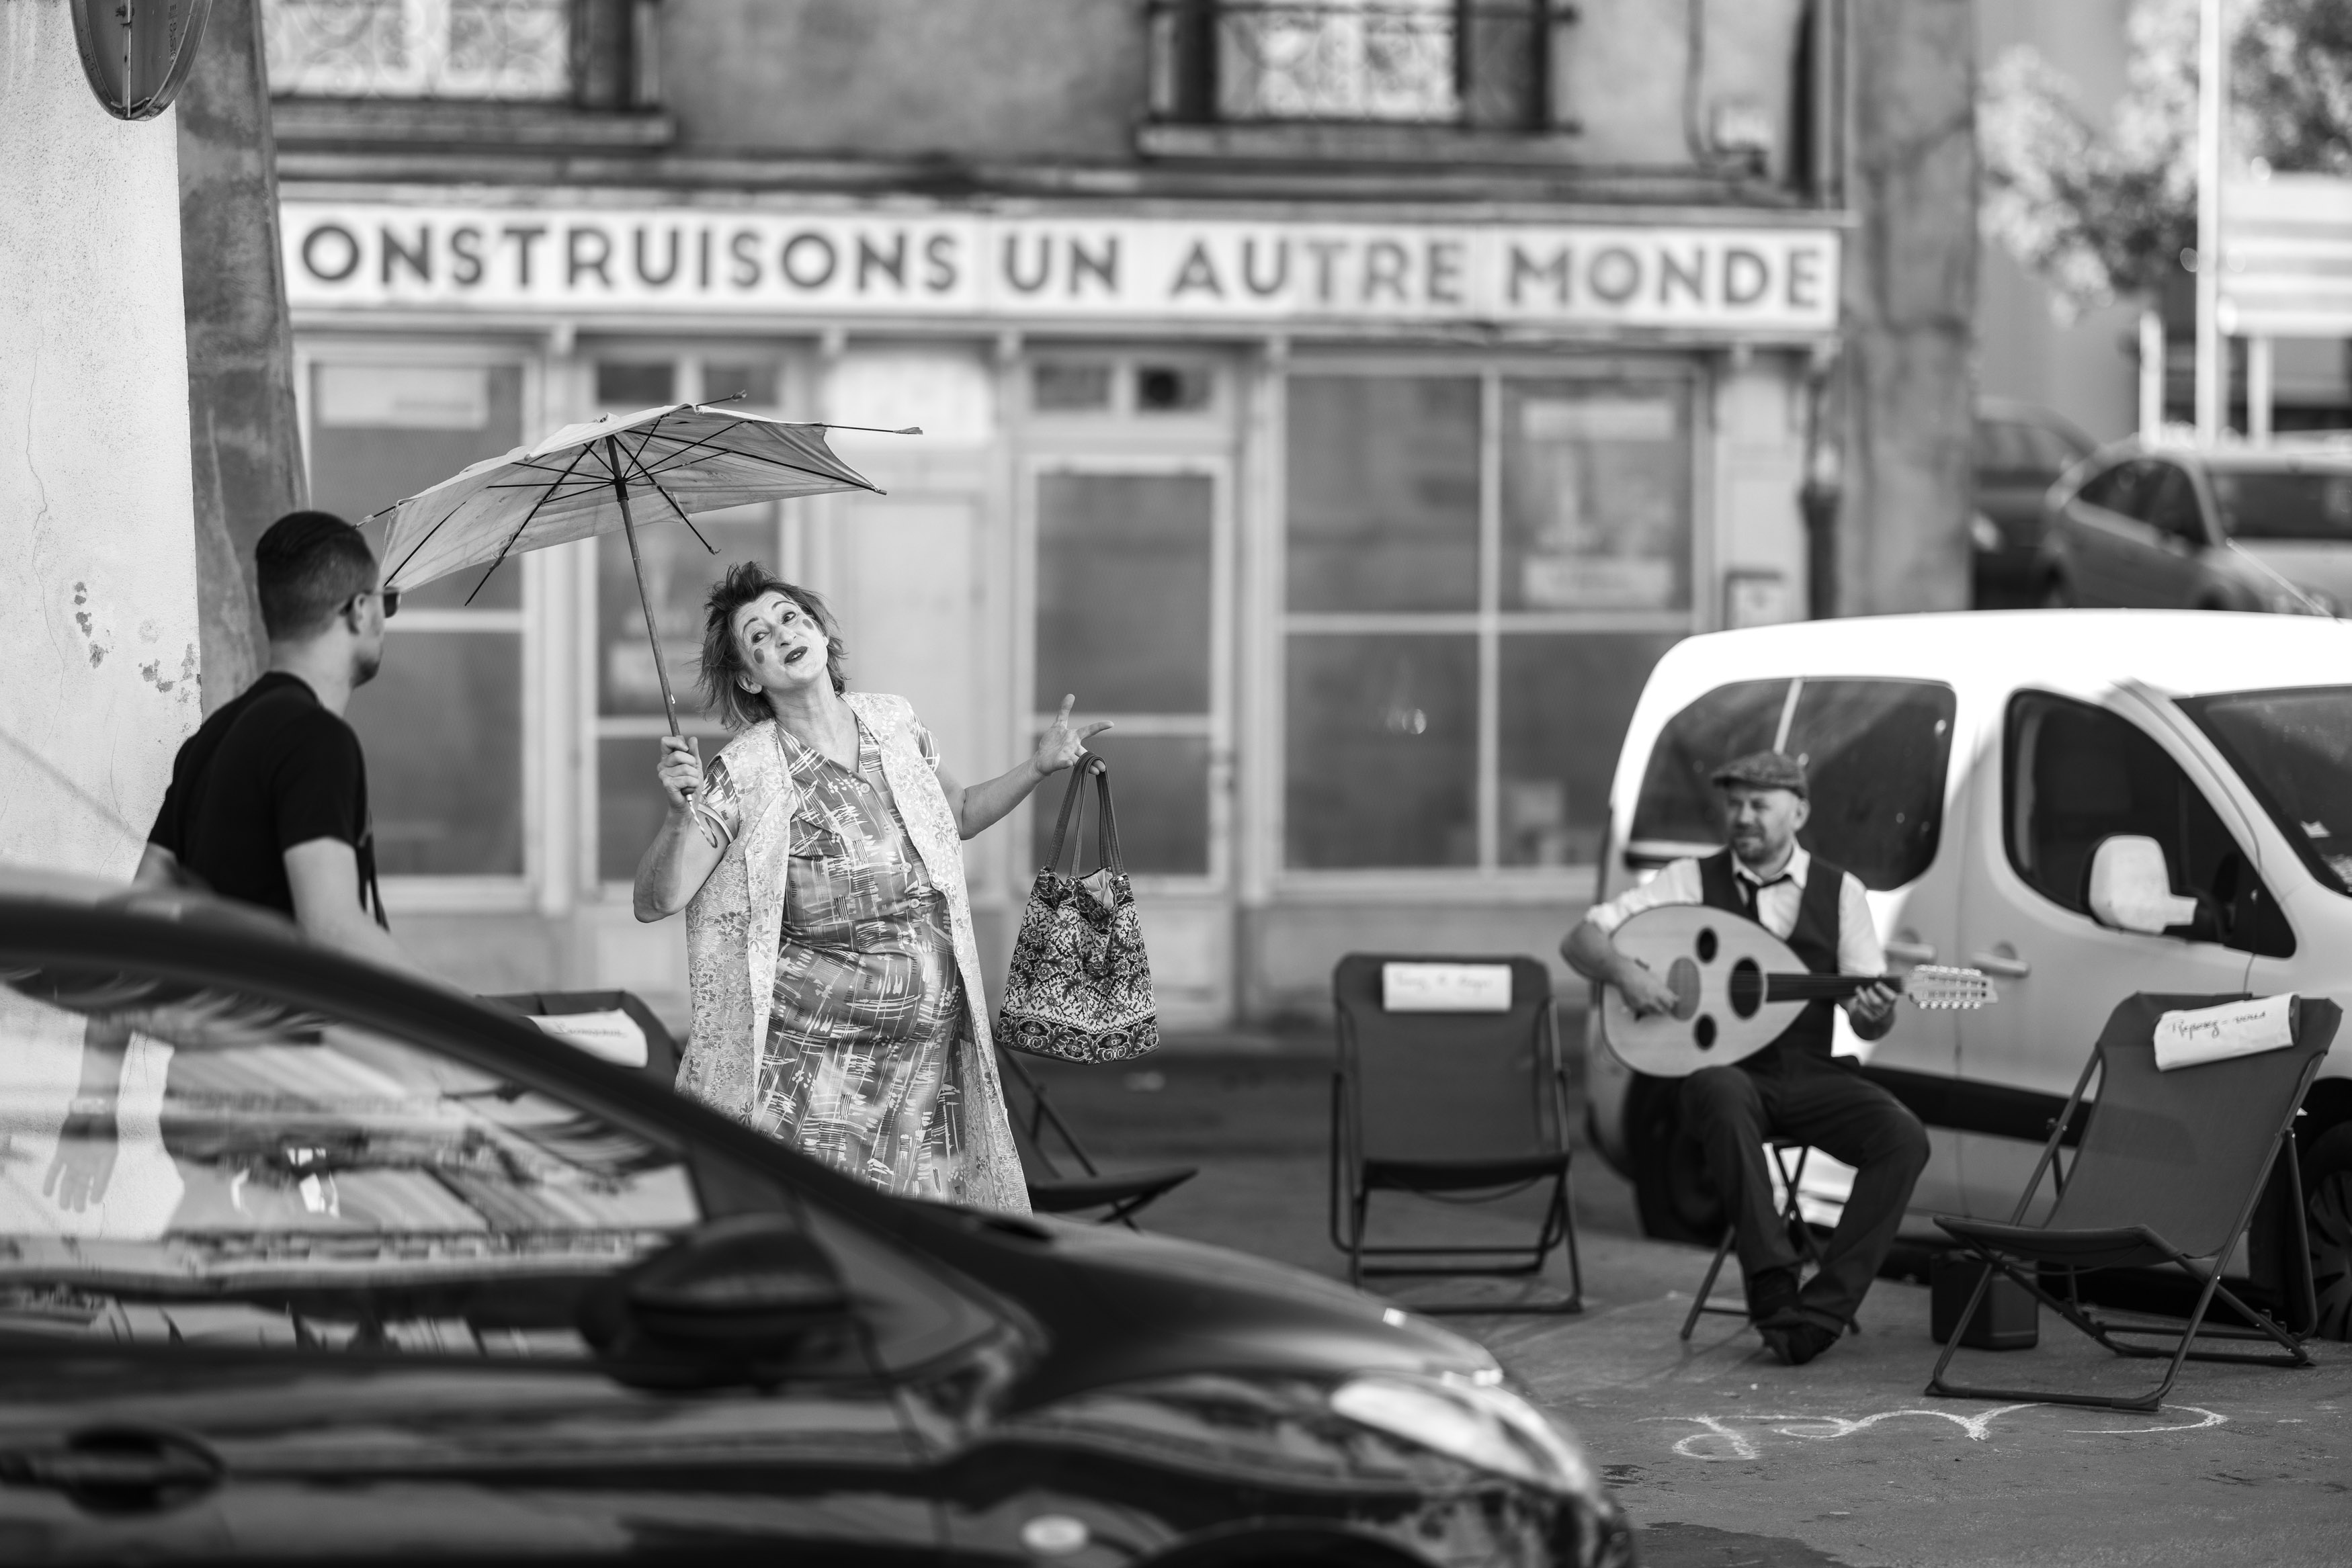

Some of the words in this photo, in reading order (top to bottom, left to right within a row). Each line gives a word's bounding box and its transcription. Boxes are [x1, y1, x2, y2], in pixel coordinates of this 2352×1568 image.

[300, 222, 958, 294] ONSTRUISONS
[999, 235, 1120, 296] UN
[1171, 238, 1472, 305] AUTRE
[1507, 245, 1824, 309] MONDE
